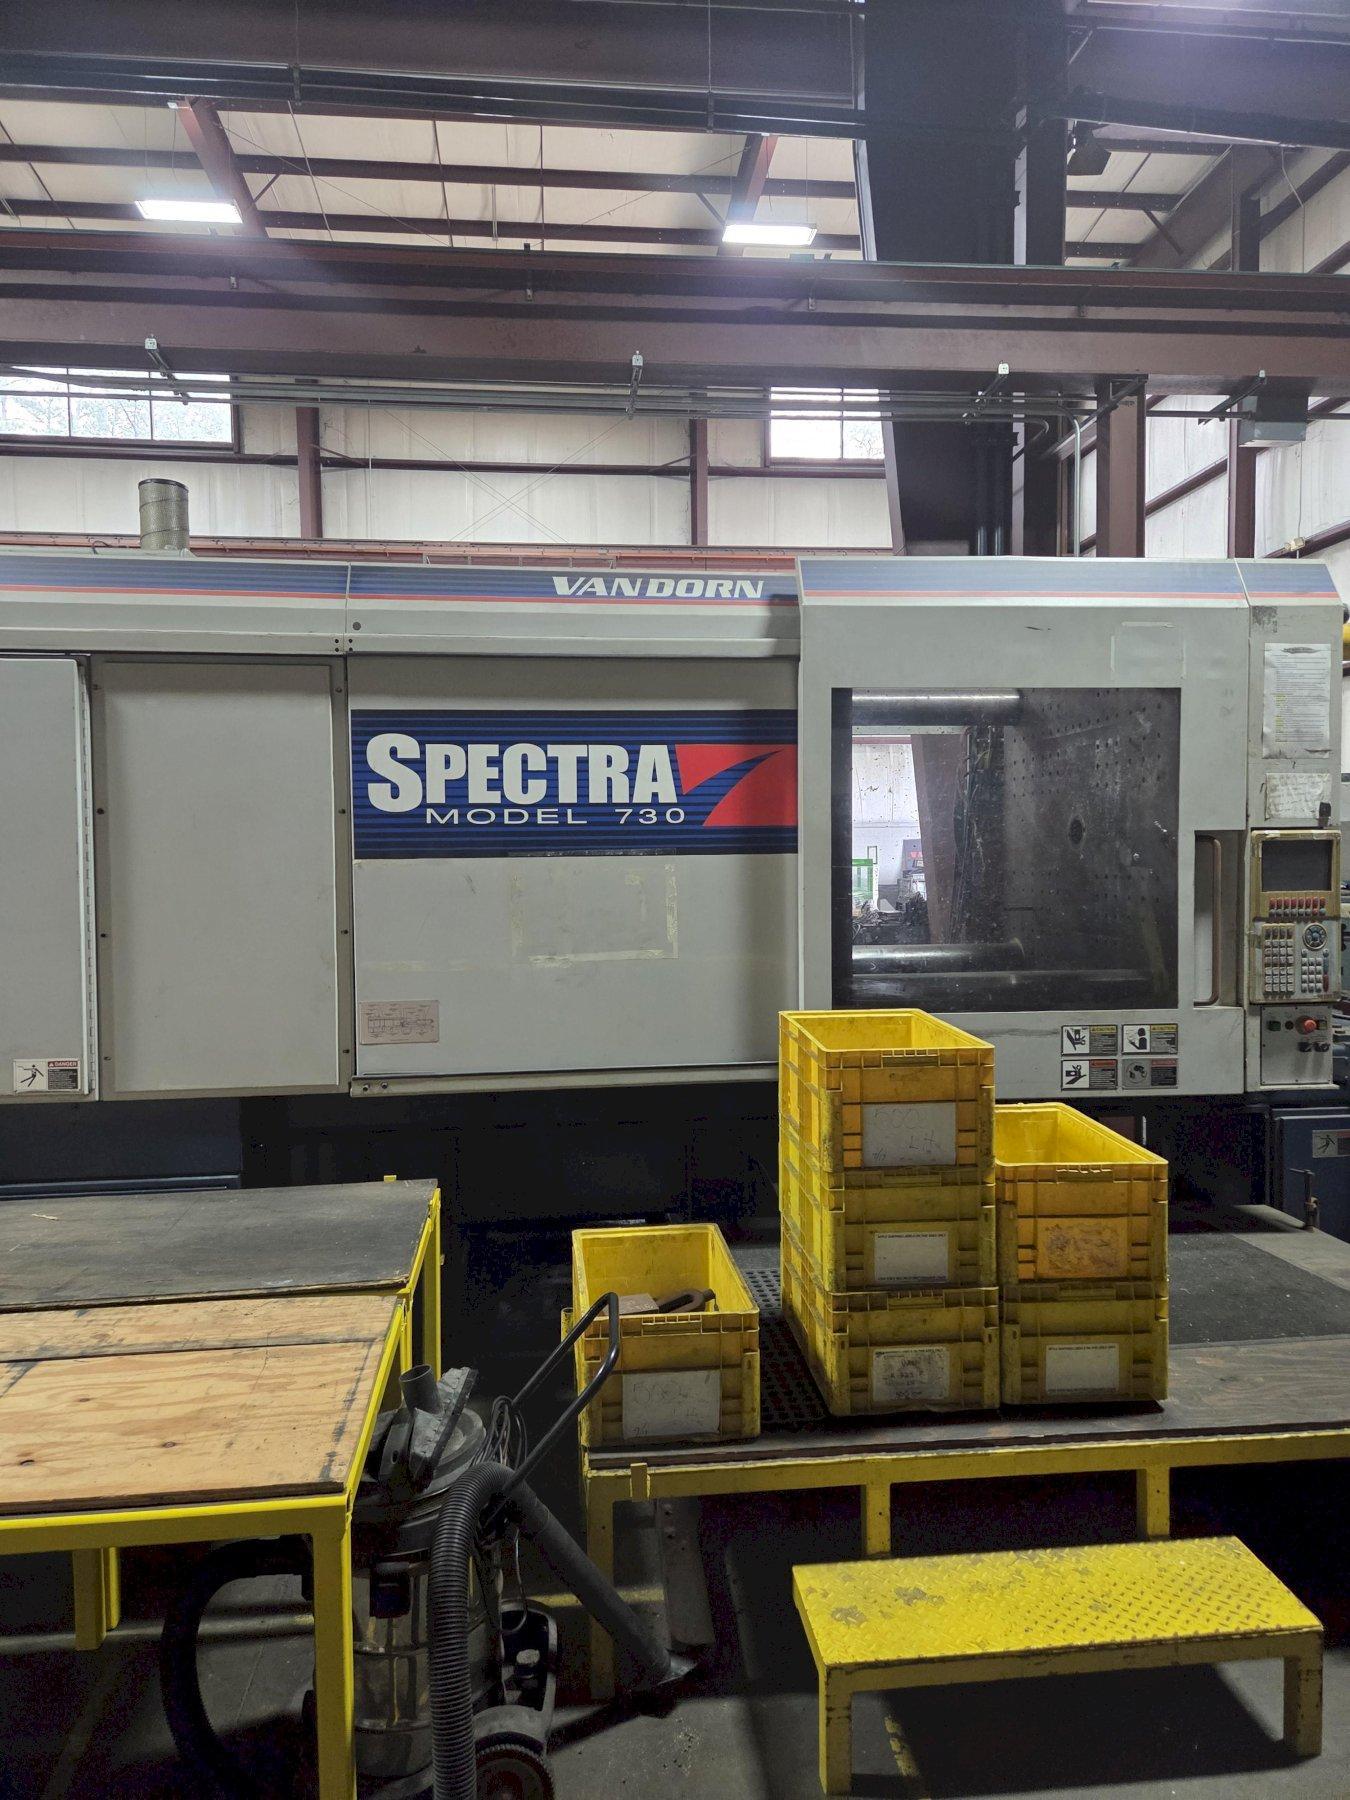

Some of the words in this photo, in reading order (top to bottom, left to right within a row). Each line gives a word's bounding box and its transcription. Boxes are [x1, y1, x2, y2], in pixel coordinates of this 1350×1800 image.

[366, 733, 678, 813] SPECTRA
[426, 808, 587, 824] MODEL
[615, 807, 685, 824] 730
